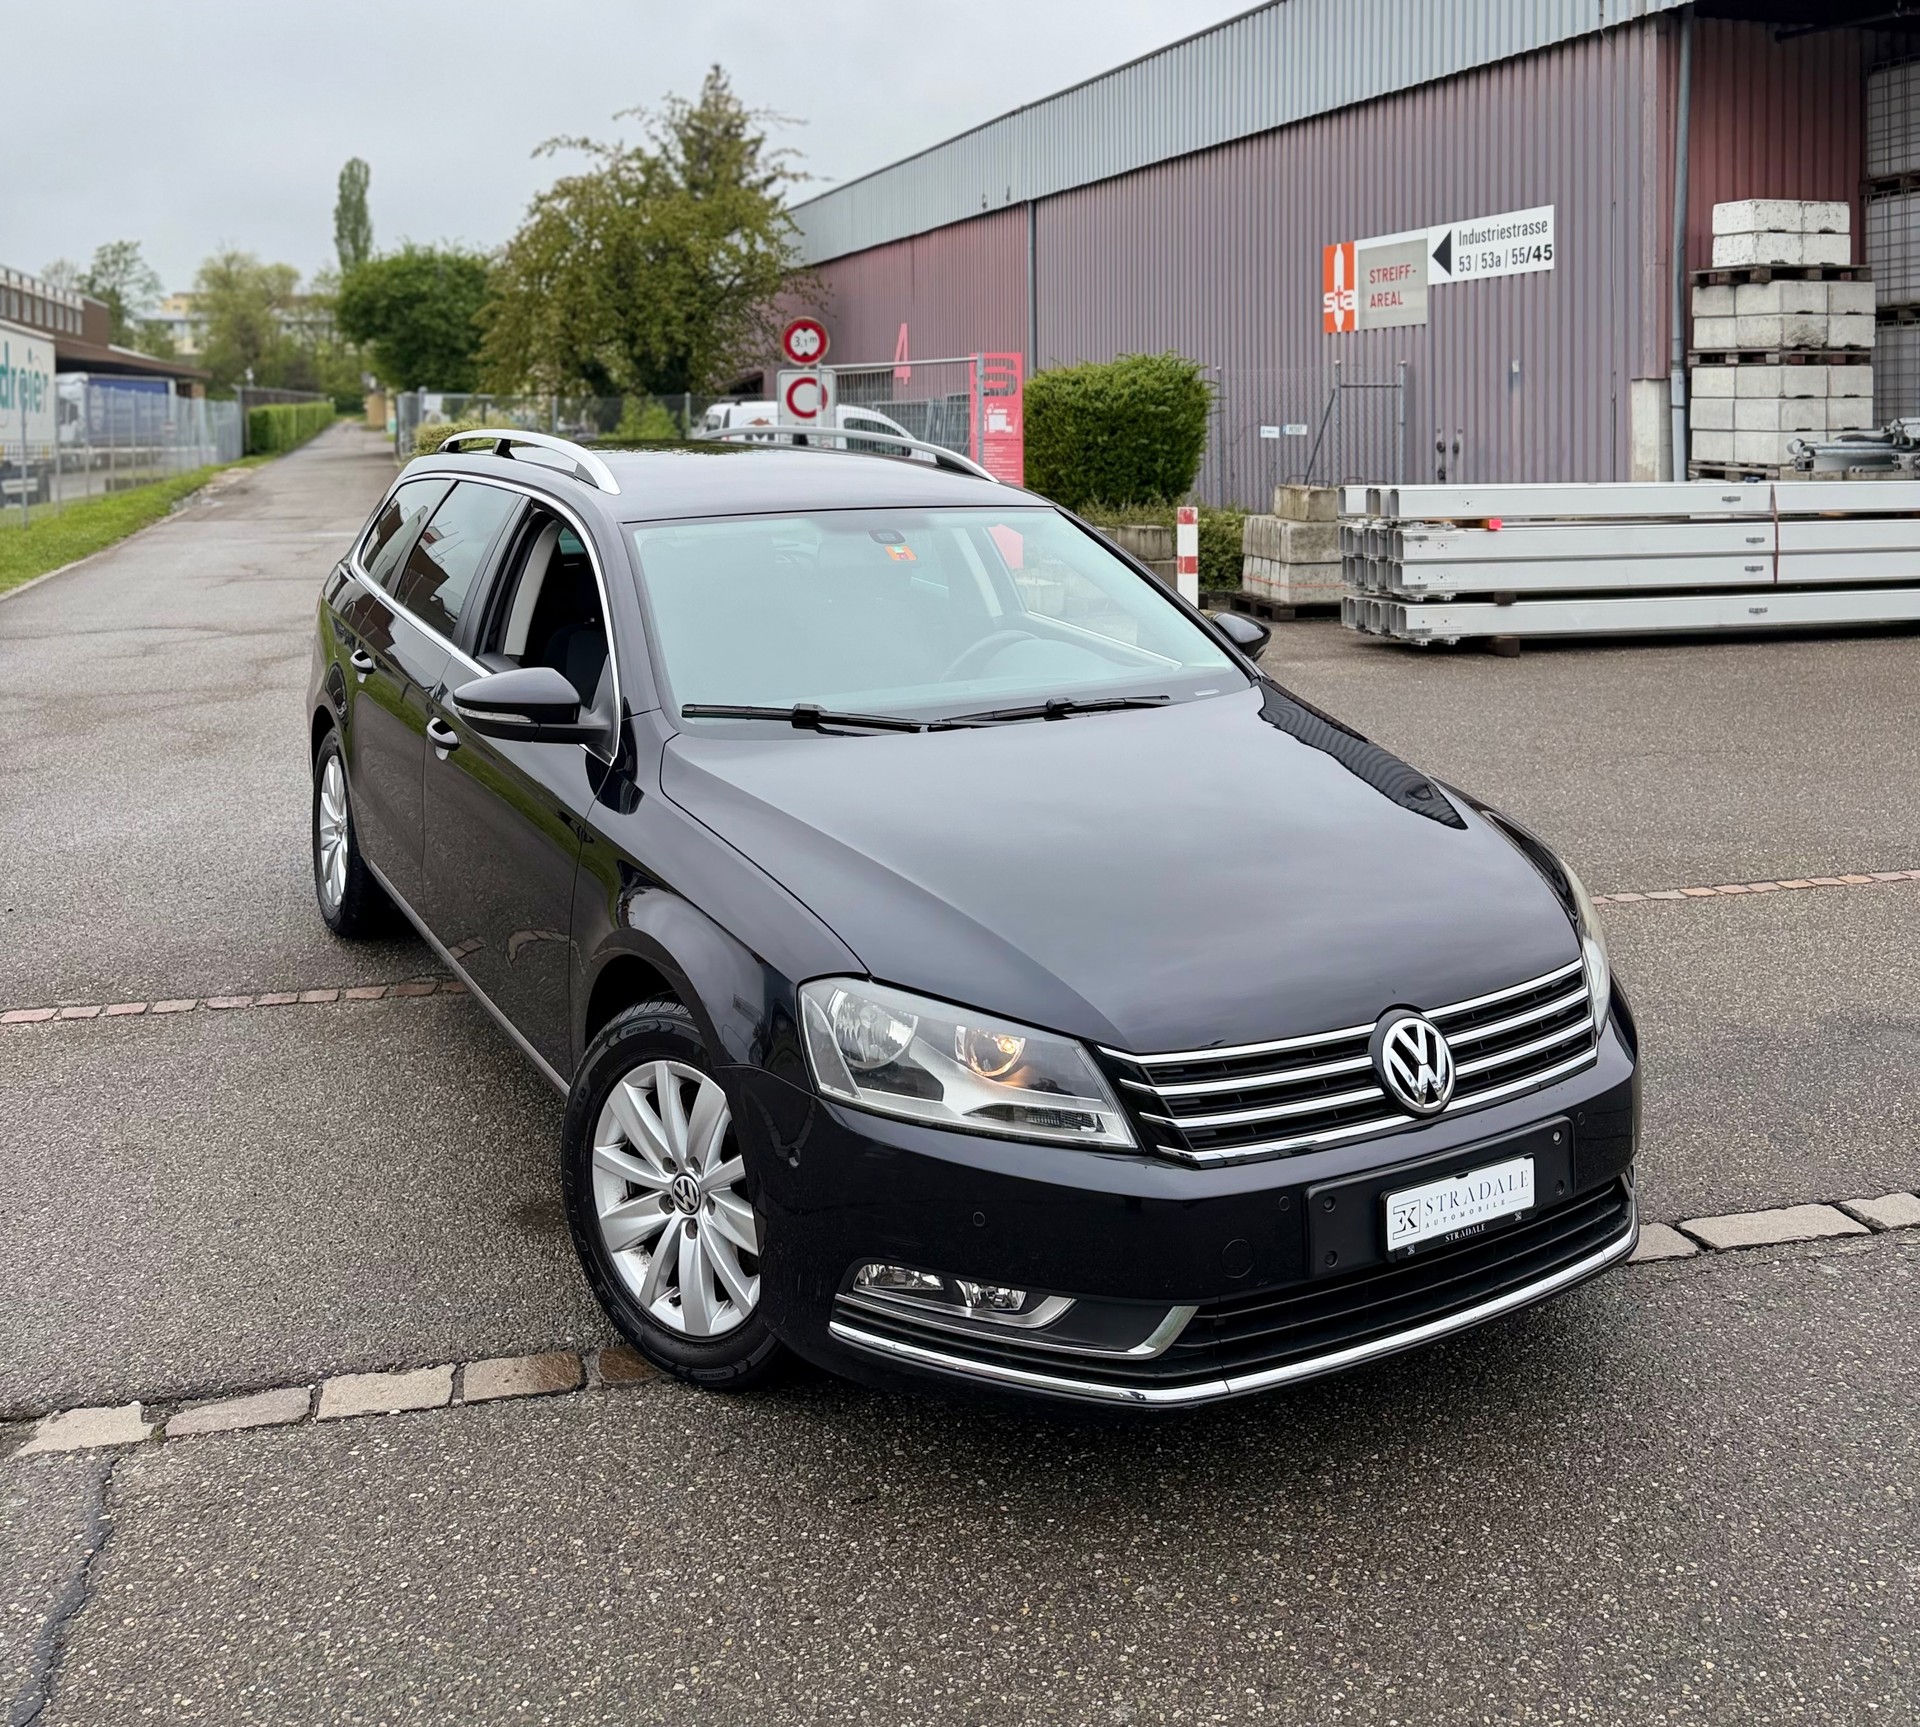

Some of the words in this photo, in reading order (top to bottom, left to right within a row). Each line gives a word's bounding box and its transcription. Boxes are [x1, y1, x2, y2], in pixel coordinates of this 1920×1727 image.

[1458, 220, 1548, 247] Industriestrasse
[1369, 264, 1417, 284] STREIFF-
[1458, 256, 1472, 273] 53
[1481, 251, 1501, 270] 53a
[1370, 291, 1403, 309] AREAL
[895, 323, 911, 385] 4
[1425, 1169, 1529, 1216] STRADALE
[1425, 1200, 1506, 1228] AUTOMOBILE
[1445, 1223, 1487, 1242] STRADALE
